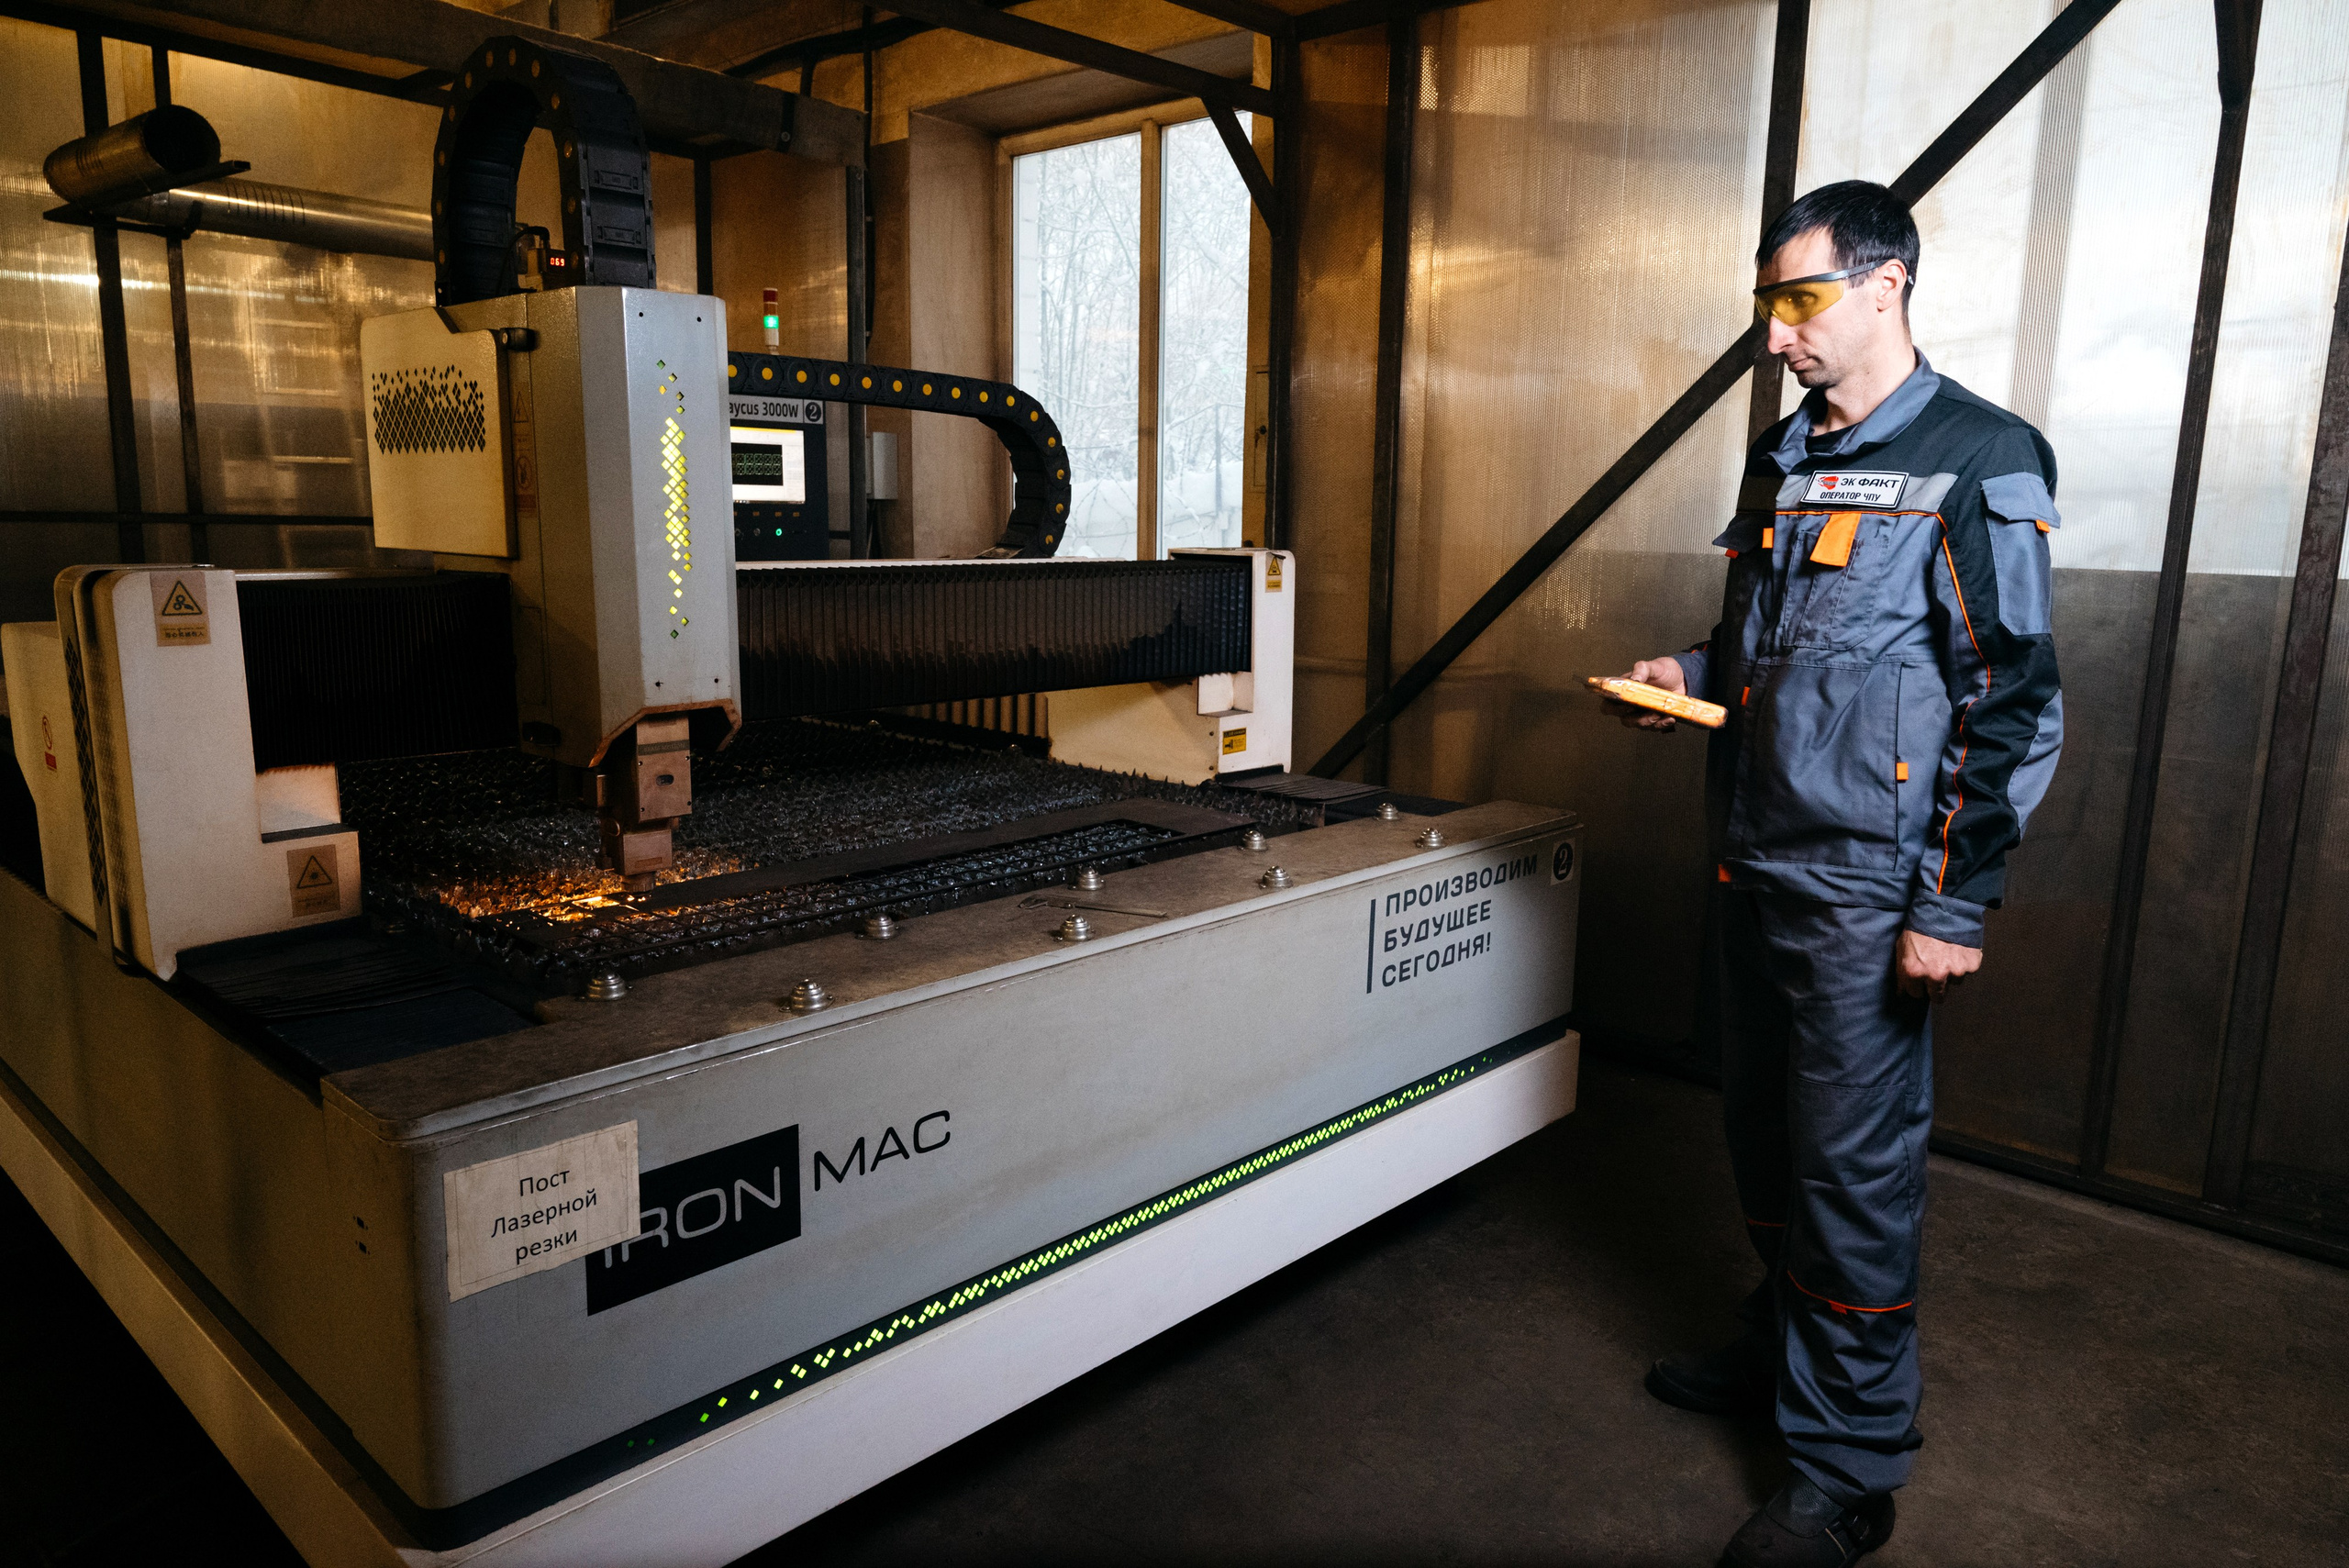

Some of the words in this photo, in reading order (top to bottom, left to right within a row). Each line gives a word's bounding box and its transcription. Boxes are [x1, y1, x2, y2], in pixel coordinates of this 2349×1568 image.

[763, 402, 798, 417] 3000W
[1820, 492, 1861, 500] ОПЕРАТОР
[1864, 493, 1881, 502] ЧПУ
[1841, 478, 1856, 486] ЭК
[1858, 478, 1899, 488] ФАКТ
[1386, 854, 1538, 917] ПРОИЗВОДИМ
[1384, 899, 1492, 952] БУДУЩЕЕ
[1382, 931, 1491, 987] СЕГОДНЯ!
[814, 1110, 951, 1192] MAC
[519, 1170, 570, 1196] Пост
[491, 1188, 596, 1238] Лазерной
[516, 1229, 578, 1265] резки
